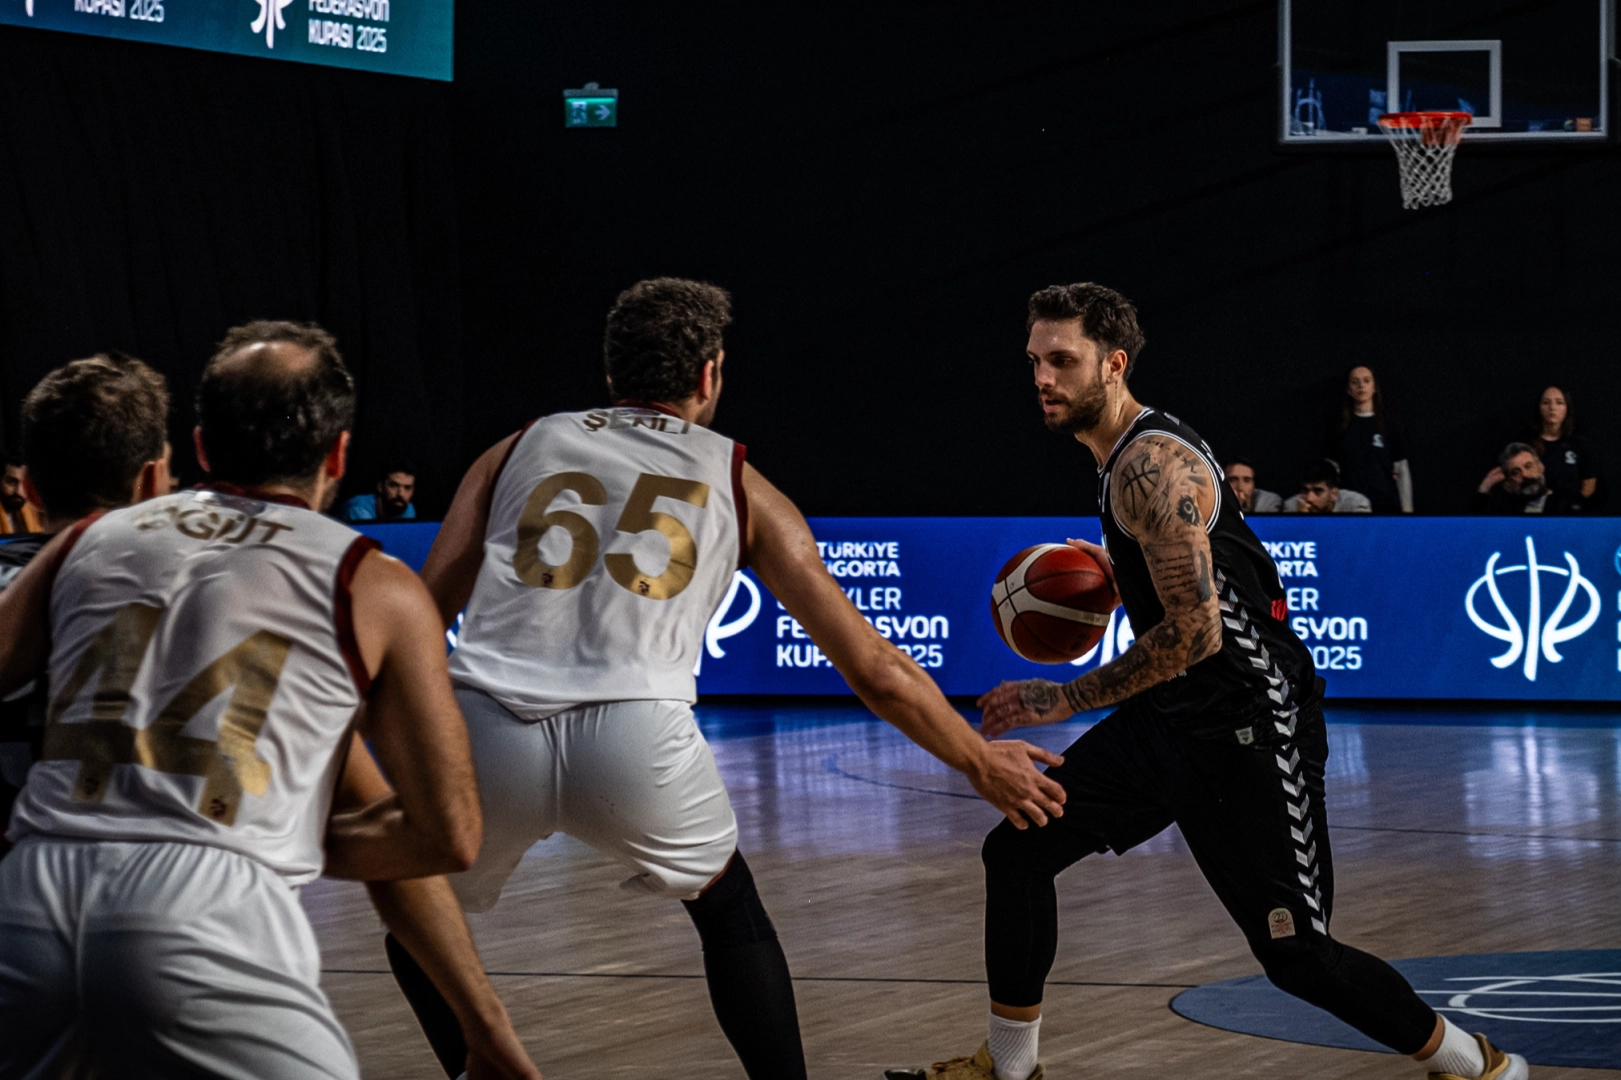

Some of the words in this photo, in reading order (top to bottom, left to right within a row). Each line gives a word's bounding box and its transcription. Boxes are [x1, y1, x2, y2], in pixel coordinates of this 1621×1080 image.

[308, 18, 354, 48] KUPASI
[356, 25, 388, 53] 2025
[513, 471, 710, 601] 65
[1307, 646, 1363, 671] 025
[42, 602, 293, 828] 44
